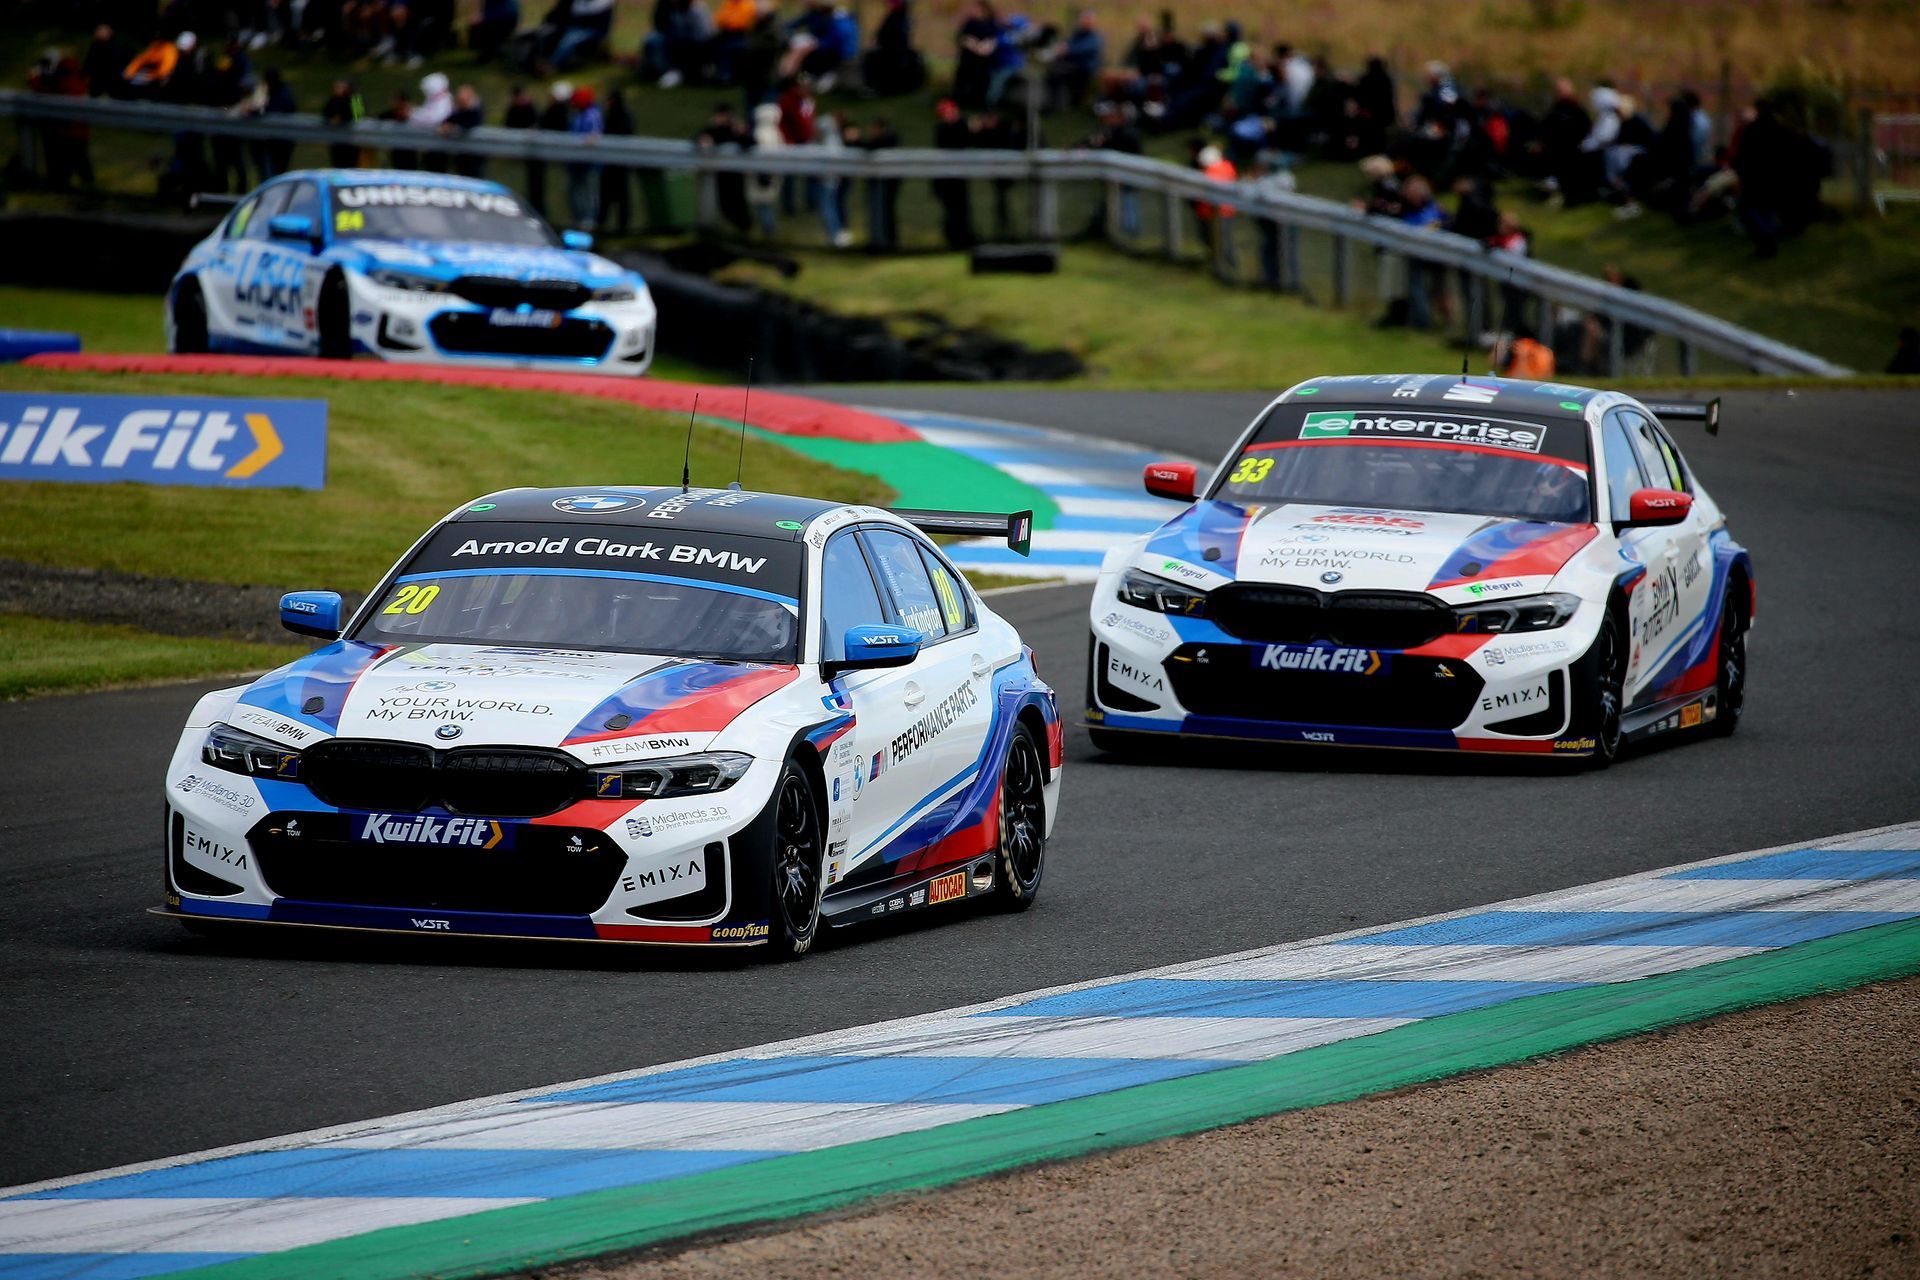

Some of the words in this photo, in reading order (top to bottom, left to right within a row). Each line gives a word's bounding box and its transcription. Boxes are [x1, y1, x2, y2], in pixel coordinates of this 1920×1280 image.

[1316, 415, 1539, 444] enterprise
[1153, 469, 1178, 481] WSR
[1229, 457, 1275, 484] 33
[1644, 498, 1677, 507] WSR
[451, 537, 570, 557] Arnold
[574, 538, 664, 560] Clark
[668, 544, 767, 574] BMW
[1260, 557, 1290, 569] My
[1295, 557, 1352, 569] BMW.
[1268, 548, 1327, 557] YOUR
[1334, 548, 1417, 564] WORLD.
[1164, 562, 1208, 580] Entegral
[933, 567, 961, 625] 20
[1470, 579, 1523, 594] Entegral
[288, 599, 318, 613] WSR
[382, 585, 441, 615] 20
[862, 635, 901, 645] WSR
[1111, 659, 1163, 691] EMIXA
[379, 697, 450, 707] YOUR
[456, 698, 554, 716] WORLD.
[1482, 685, 1547, 711] EMIXA
[367, 709, 402, 722] My
[407, 708, 475, 722] BMW.
[241, 712, 311, 741] #TEAMBMW
[891, 692, 953, 767] PERFORMANCE
[1302, 731, 1334, 742] WSR
[593, 737, 690, 757] #TEAMBMW
[199, 779, 240, 802] Midlands
[239, 795, 256, 808] 3D
[651, 809, 707, 826] Midlands
[709, 806, 728, 816] 3D
[654, 825, 665, 833] 3D
[666, 821, 682, 830] Print
[682, 815, 732, 827] Manufacturing
[186, 830, 248, 870] EMIXA
[566, 845, 582, 853] TOW
[622, 860, 701, 892] EMIXA
[930, 874, 963, 903] AUTOCAR
[410, 918, 450, 930] WSR
[712, 923, 769, 939] GOODYEAR
